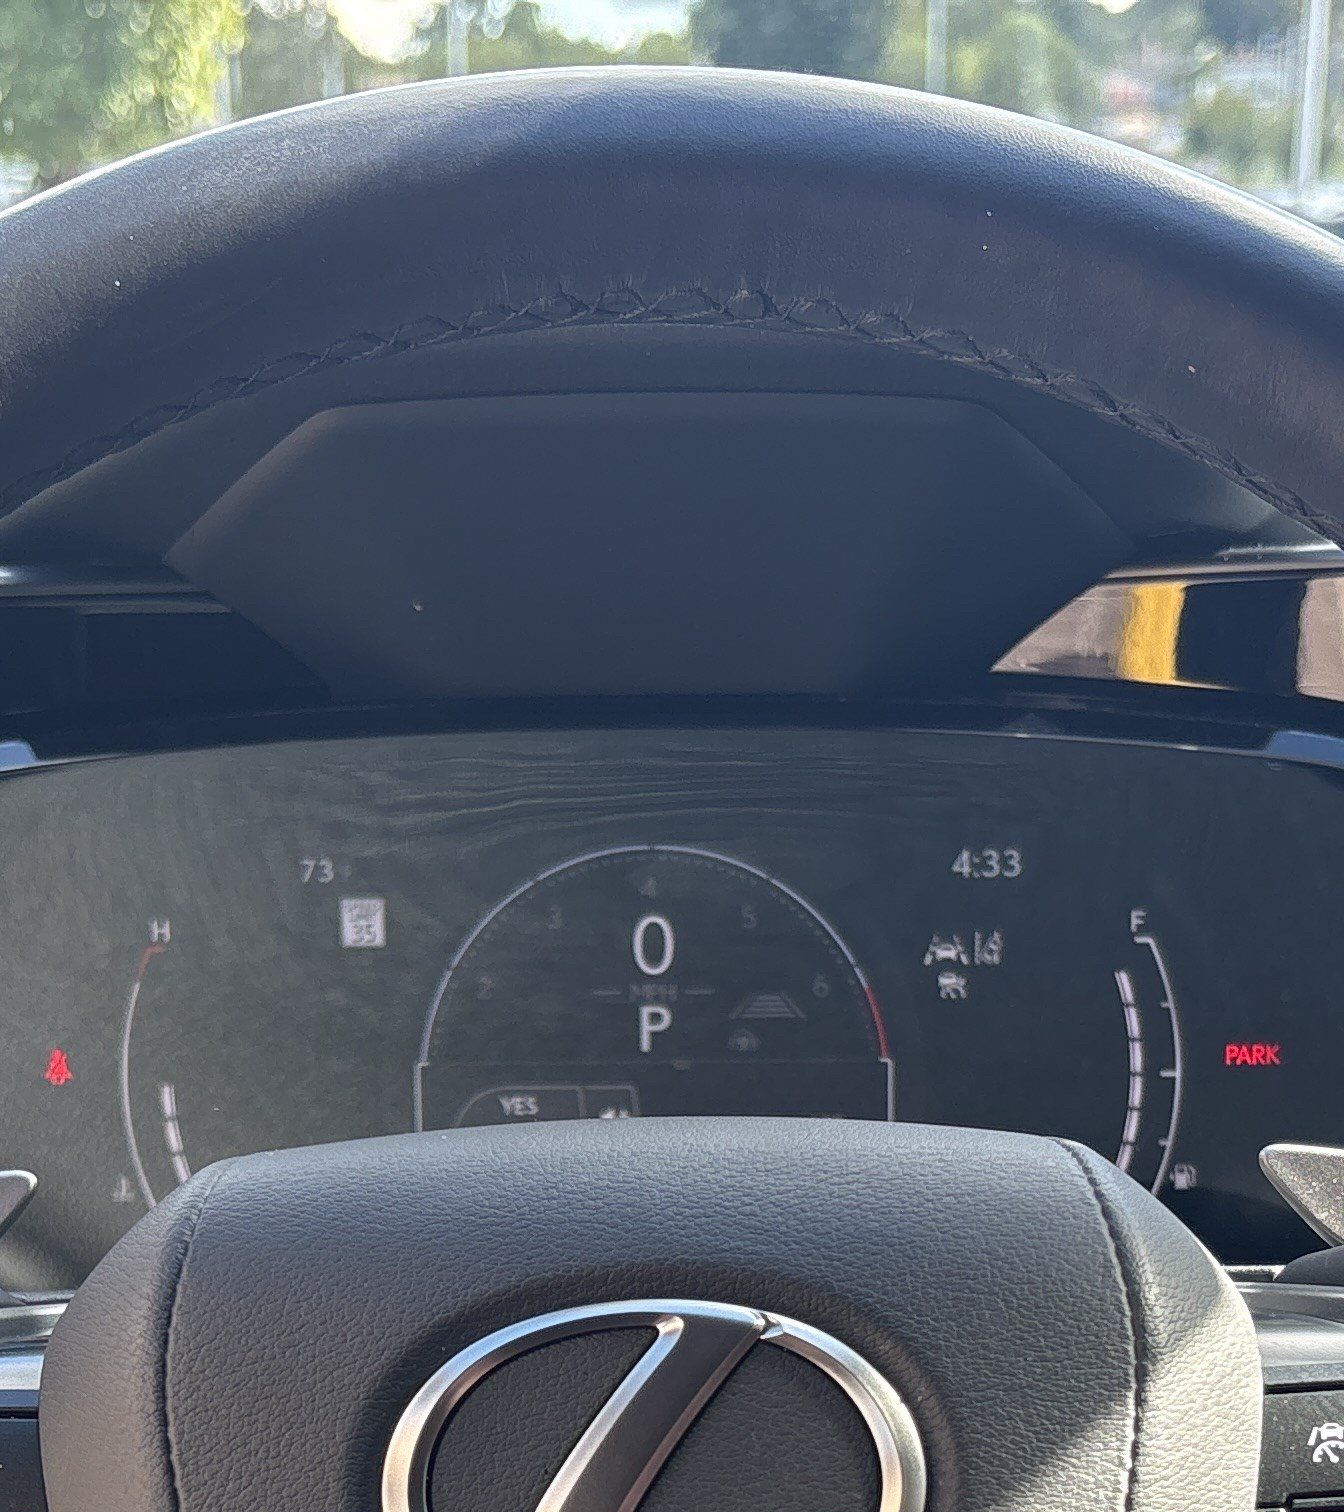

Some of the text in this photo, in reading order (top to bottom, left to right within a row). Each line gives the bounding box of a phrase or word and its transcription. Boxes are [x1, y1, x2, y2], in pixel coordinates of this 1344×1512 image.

[951, 849, 1022, 879] 4:33
[1129, 909, 1148, 932] F
[632, 915, 676, 976] 0
[639, 1004, 673, 1052] P
[1224, 1043, 1281, 1066] PARK
[499, 1096, 539, 1117] YES
